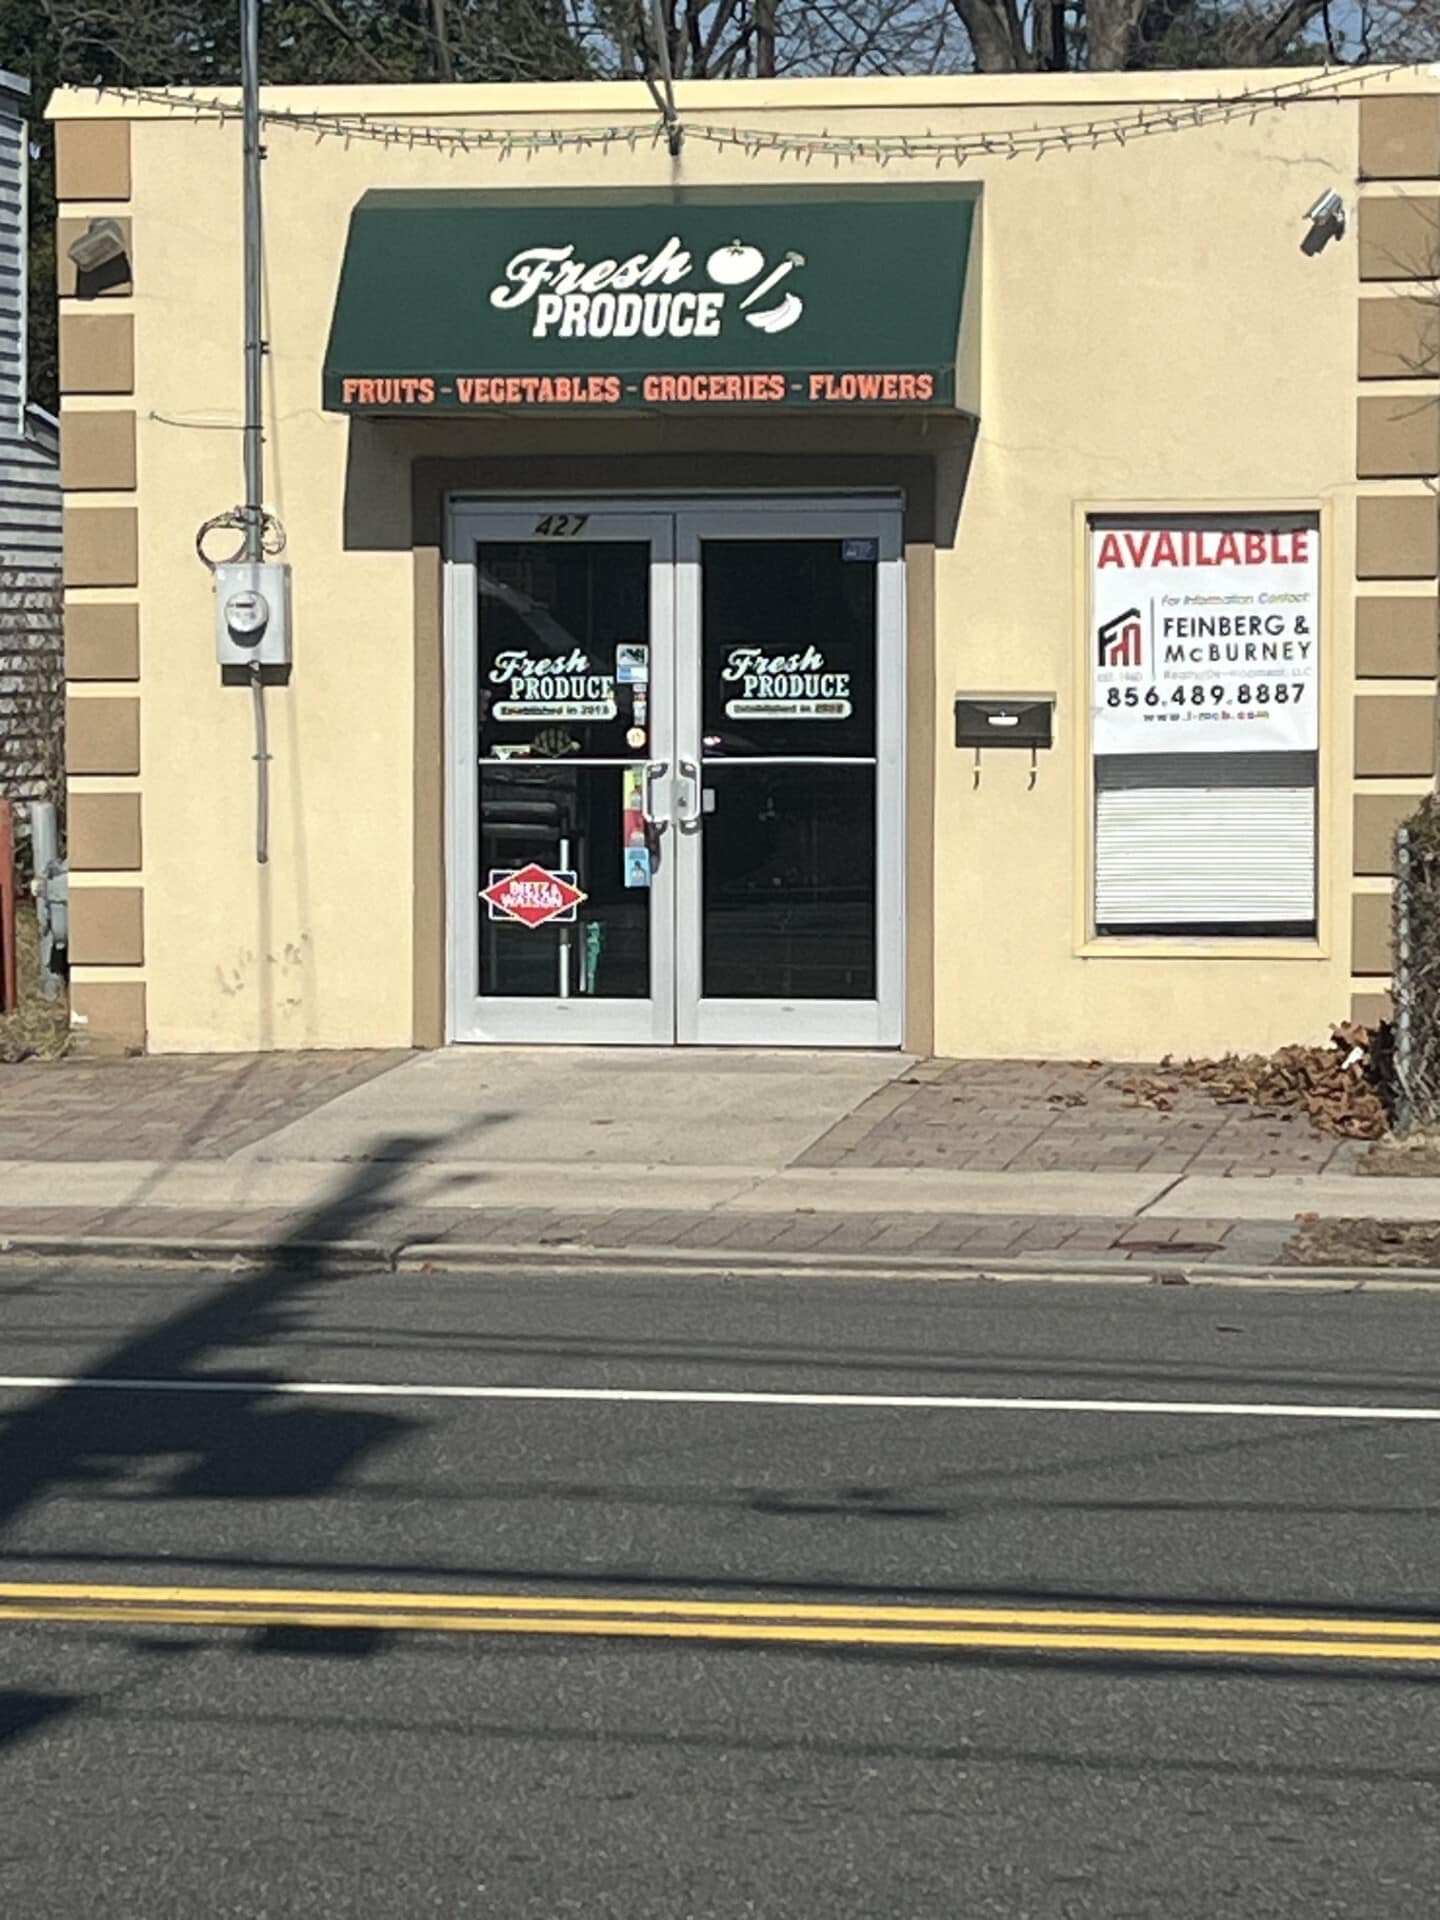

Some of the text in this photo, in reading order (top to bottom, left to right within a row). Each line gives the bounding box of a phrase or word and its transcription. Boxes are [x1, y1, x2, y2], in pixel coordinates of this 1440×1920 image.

[490, 236, 693, 309] Fresh
[532, 292, 723, 337] PRODUCE
[342, 377, 436, 404] FRUITS
[456, 376, 621, 403] VEGETABLES
[643, 374, 785, 401] GROCERIES
[808, 372, 934, 400] FLOWERS
[535, 513, 590, 536] 427
[1097, 529, 1310, 569] AVAILABLE
[1163, 615, 1311, 638] FEINBERG &
[488, 648, 590, 683] Fresh
[721, 645, 824, 681] Fresh
[510, 676, 614, 700] PRODUCE
[743, 674, 850, 698] PRODUCE
[1107, 683, 1305, 708] 856.489.8887
